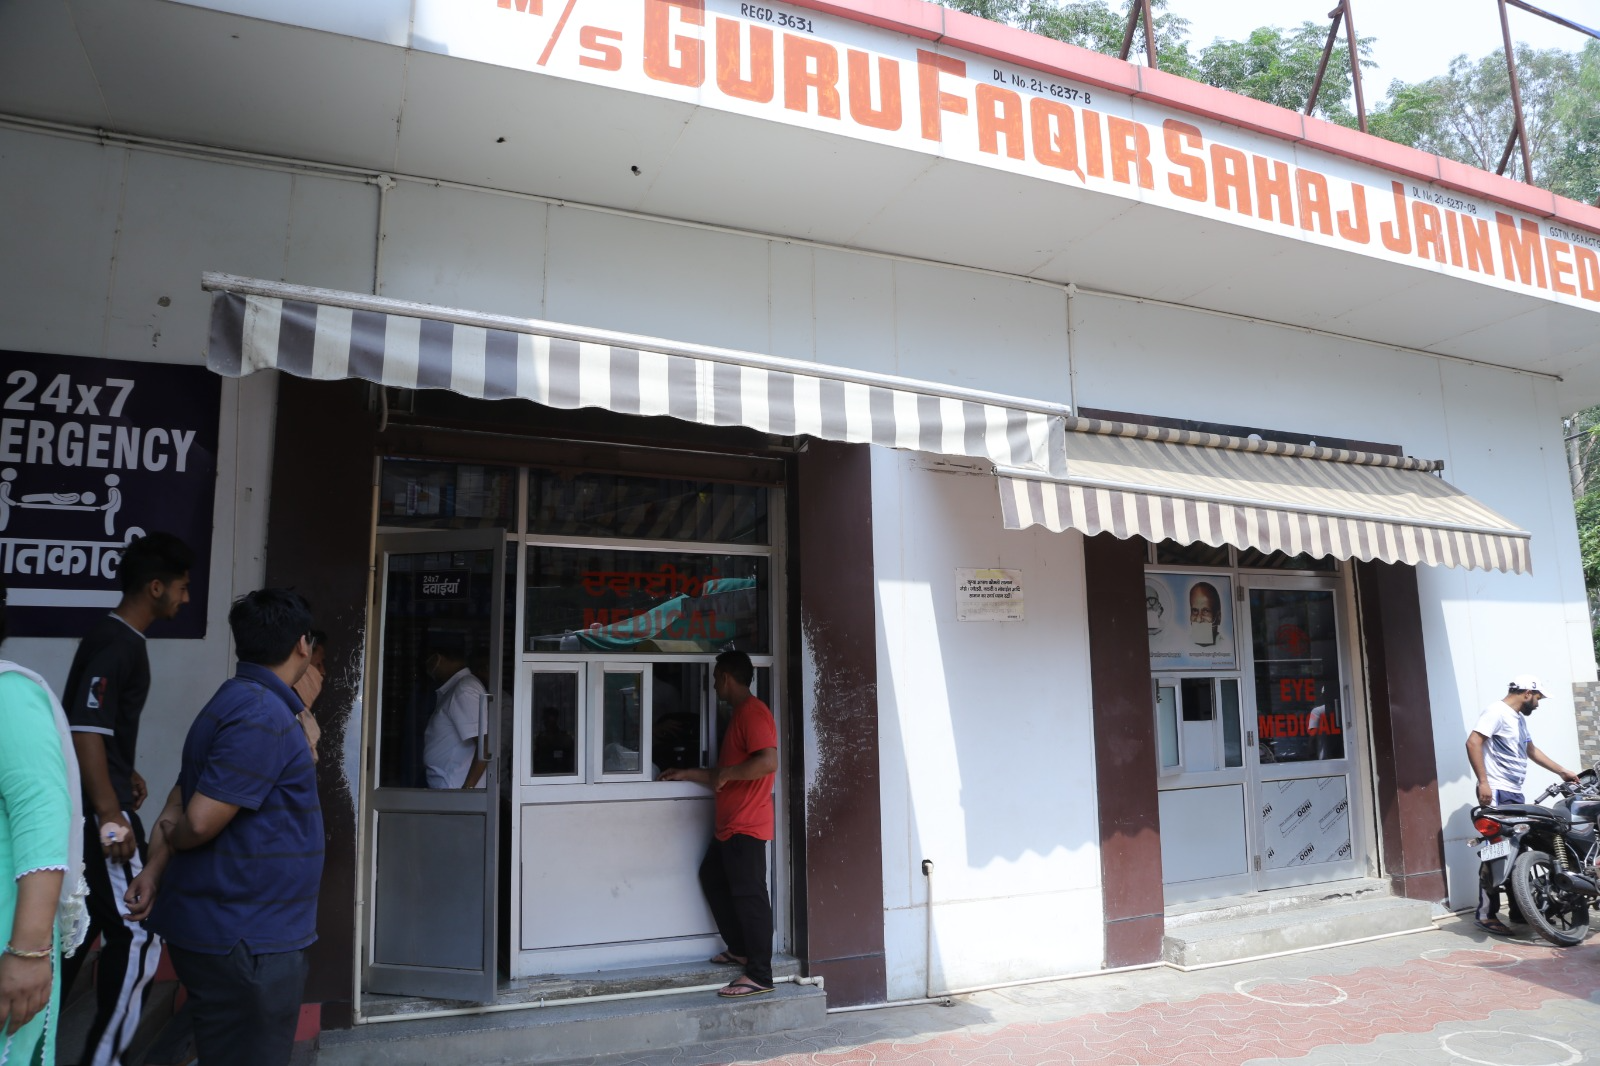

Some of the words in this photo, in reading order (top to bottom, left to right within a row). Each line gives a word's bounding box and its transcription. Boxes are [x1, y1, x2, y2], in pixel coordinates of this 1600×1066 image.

[993, 69, 1007, 83] DL
[643, 0, 903, 131] GURU
[916, 48, 1154, 190] FAQIR
[1163, 118, 1371, 244] SAHAJ
[1380, 180, 1496, 276] JAIN
[0, 418, 197, 473] ERGENCY
[582, 607, 726, 639] MEDICAL
[1280, 678, 1316, 702] EYE
[1258, 712, 1341, 738] MEDICAL
